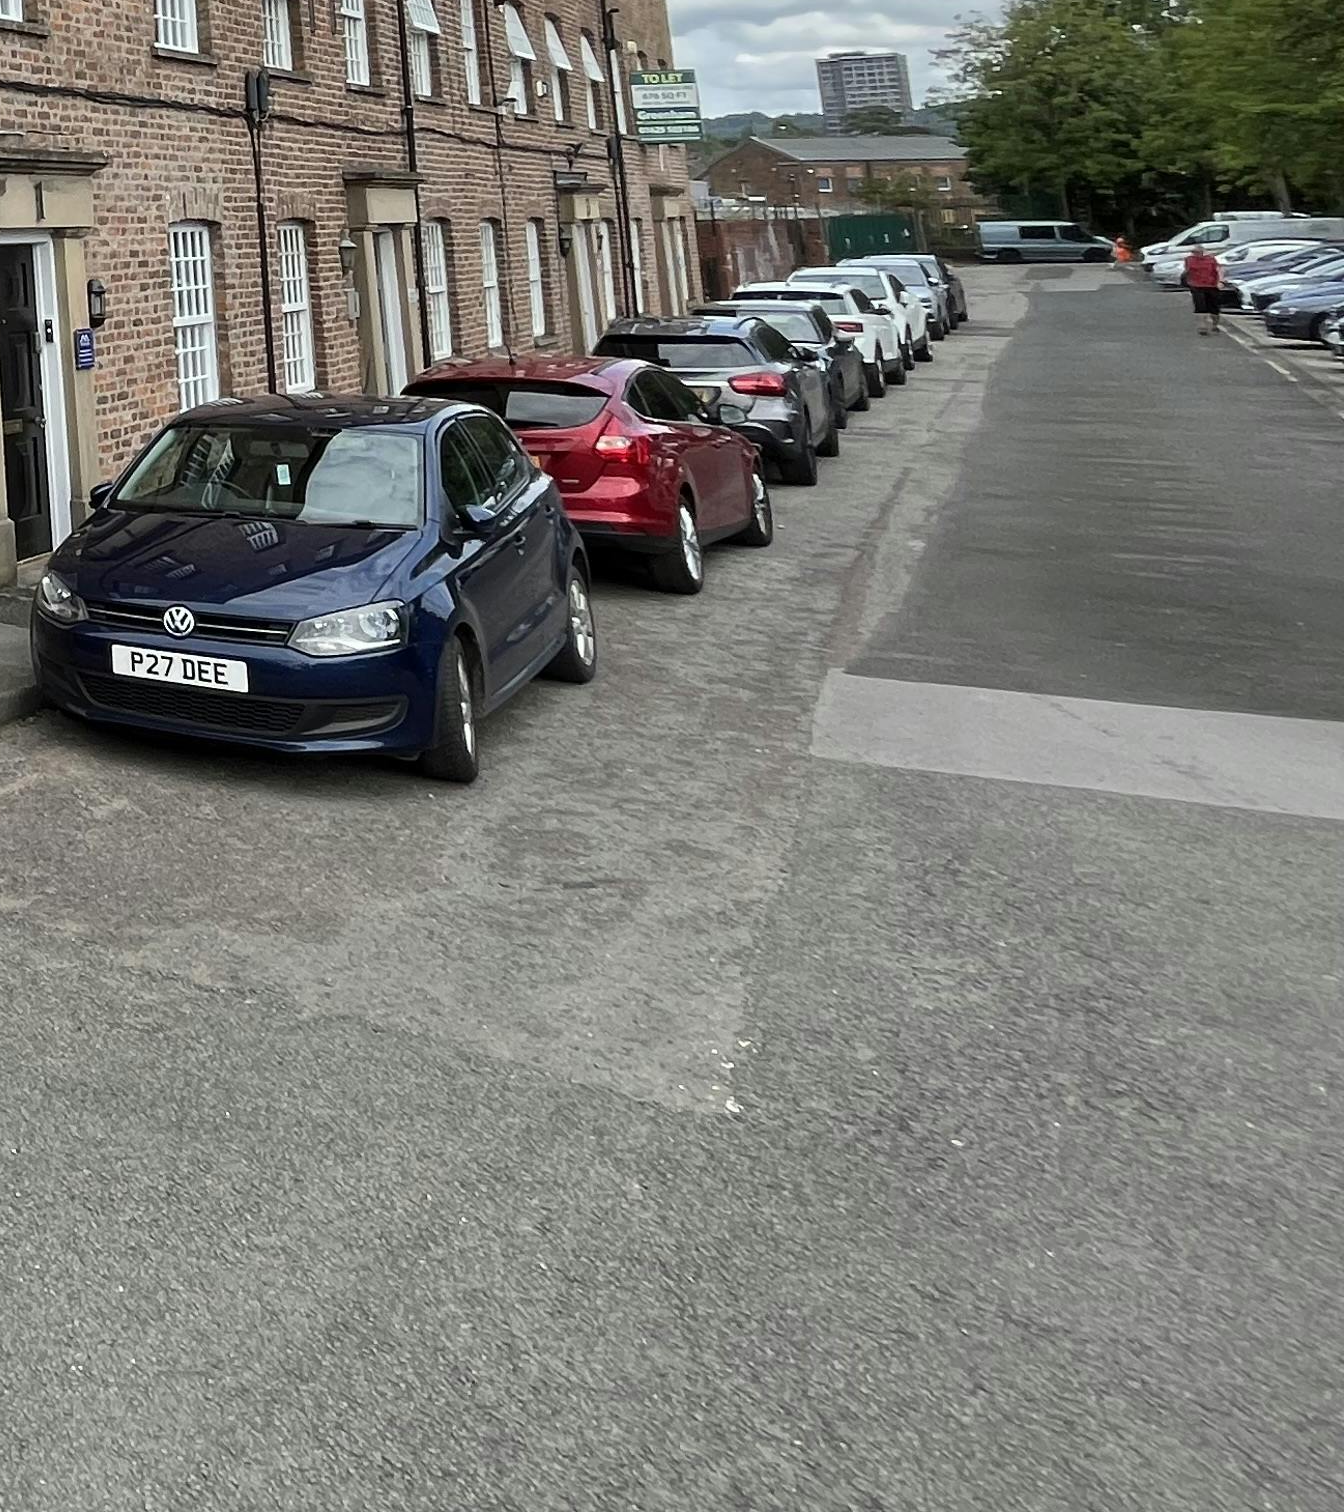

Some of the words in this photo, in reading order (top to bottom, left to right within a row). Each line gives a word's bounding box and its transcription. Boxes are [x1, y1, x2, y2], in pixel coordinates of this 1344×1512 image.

[641, 73, 660, 84] TO
[660, 73, 683, 83] LET
[130, 651, 173, 677] P27
[181, 658, 229, 685] DEE
